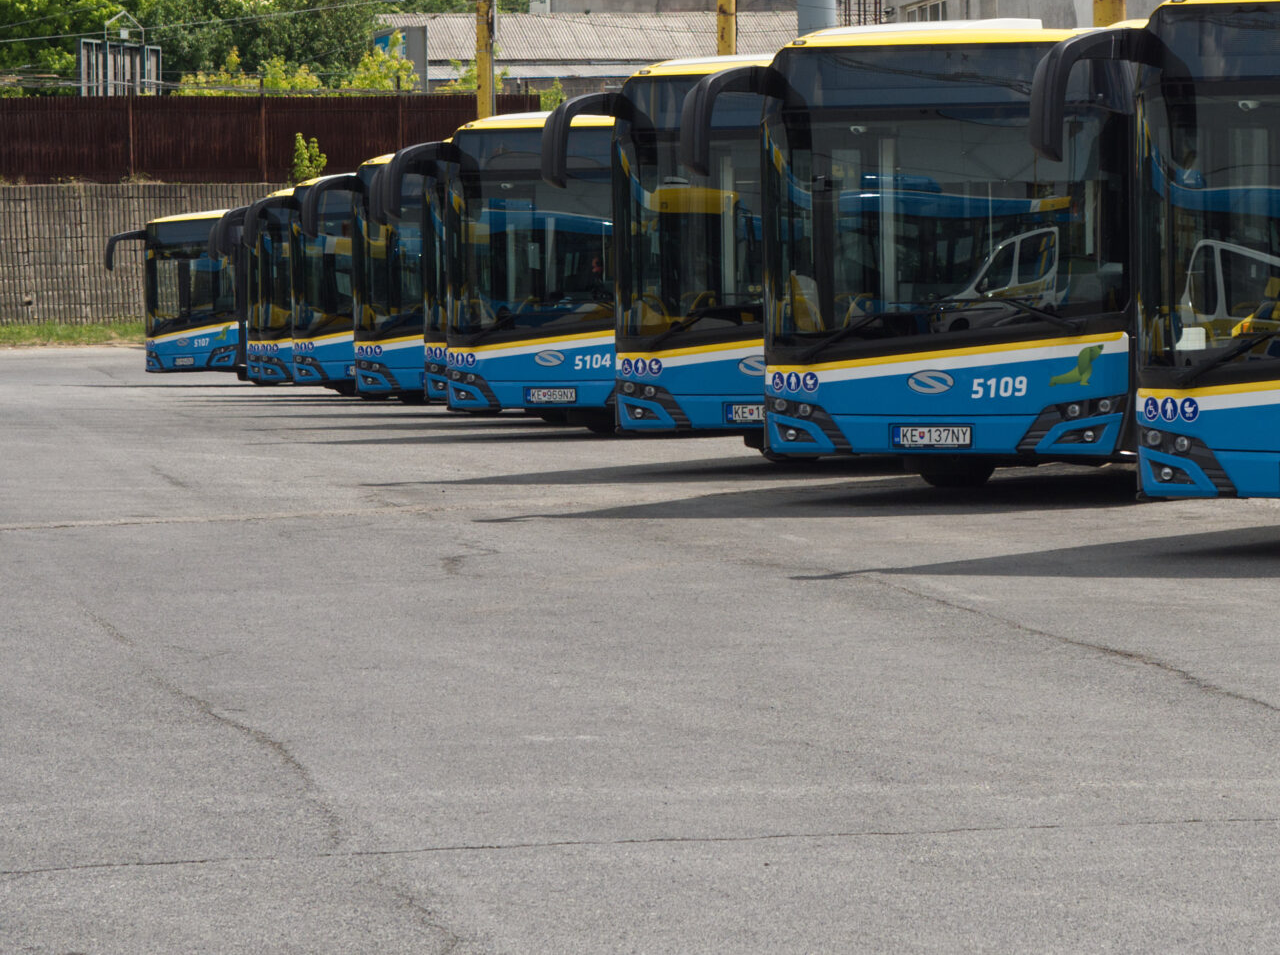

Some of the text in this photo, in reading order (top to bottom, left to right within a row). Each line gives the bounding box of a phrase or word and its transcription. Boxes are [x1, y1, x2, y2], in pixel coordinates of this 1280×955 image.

[193, 337, 210, 348] 5107
[573, 353, 612, 370] 5104
[970, 375, 1028, 399] 5109
